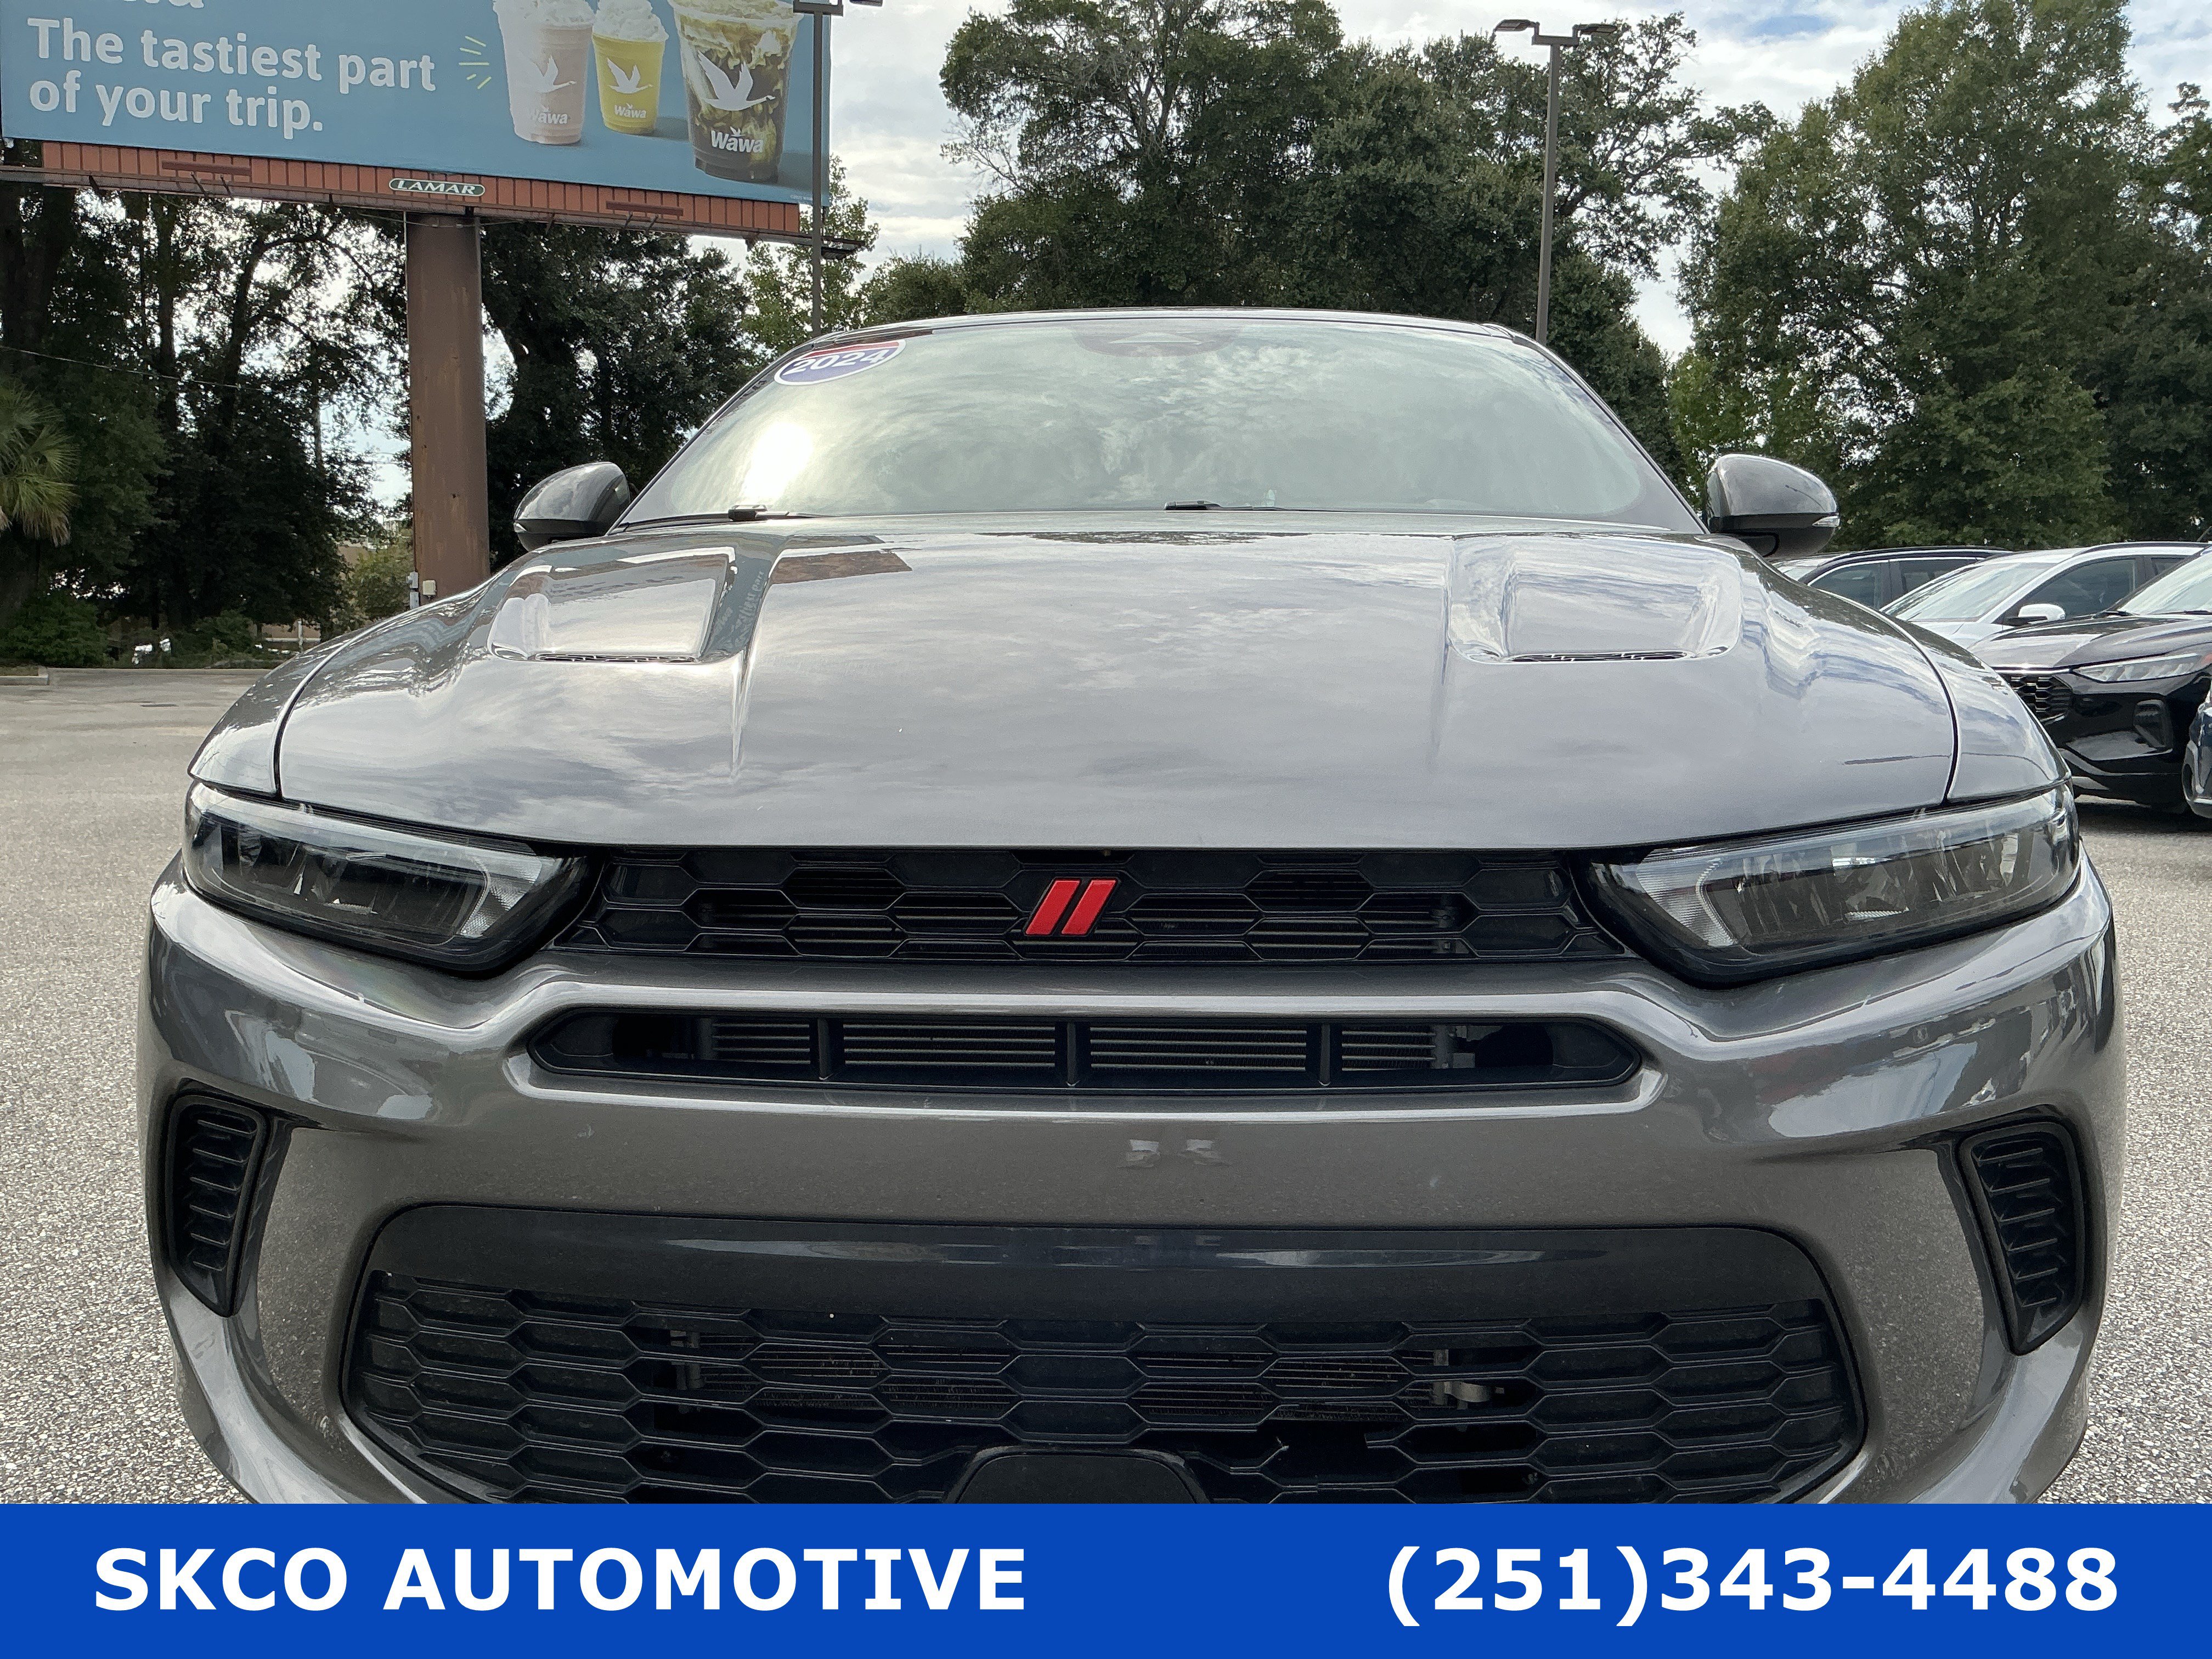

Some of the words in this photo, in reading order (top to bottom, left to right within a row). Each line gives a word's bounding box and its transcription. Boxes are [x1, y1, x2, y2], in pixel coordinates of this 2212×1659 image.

[27, 18, 124, 65] The
[140, 30, 323, 82] tastiest
[338, 54, 436, 94] part
[30, 70, 82, 113] of
[95, 84, 212, 127] your
[225, 86, 323, 140] trip.
[614, 104, 647, 119] Wawa
[710, 129, 764, 153] Wawa
[397, 180, 476, 194] LAMAR
[782, 349, 890, 376] 2024
